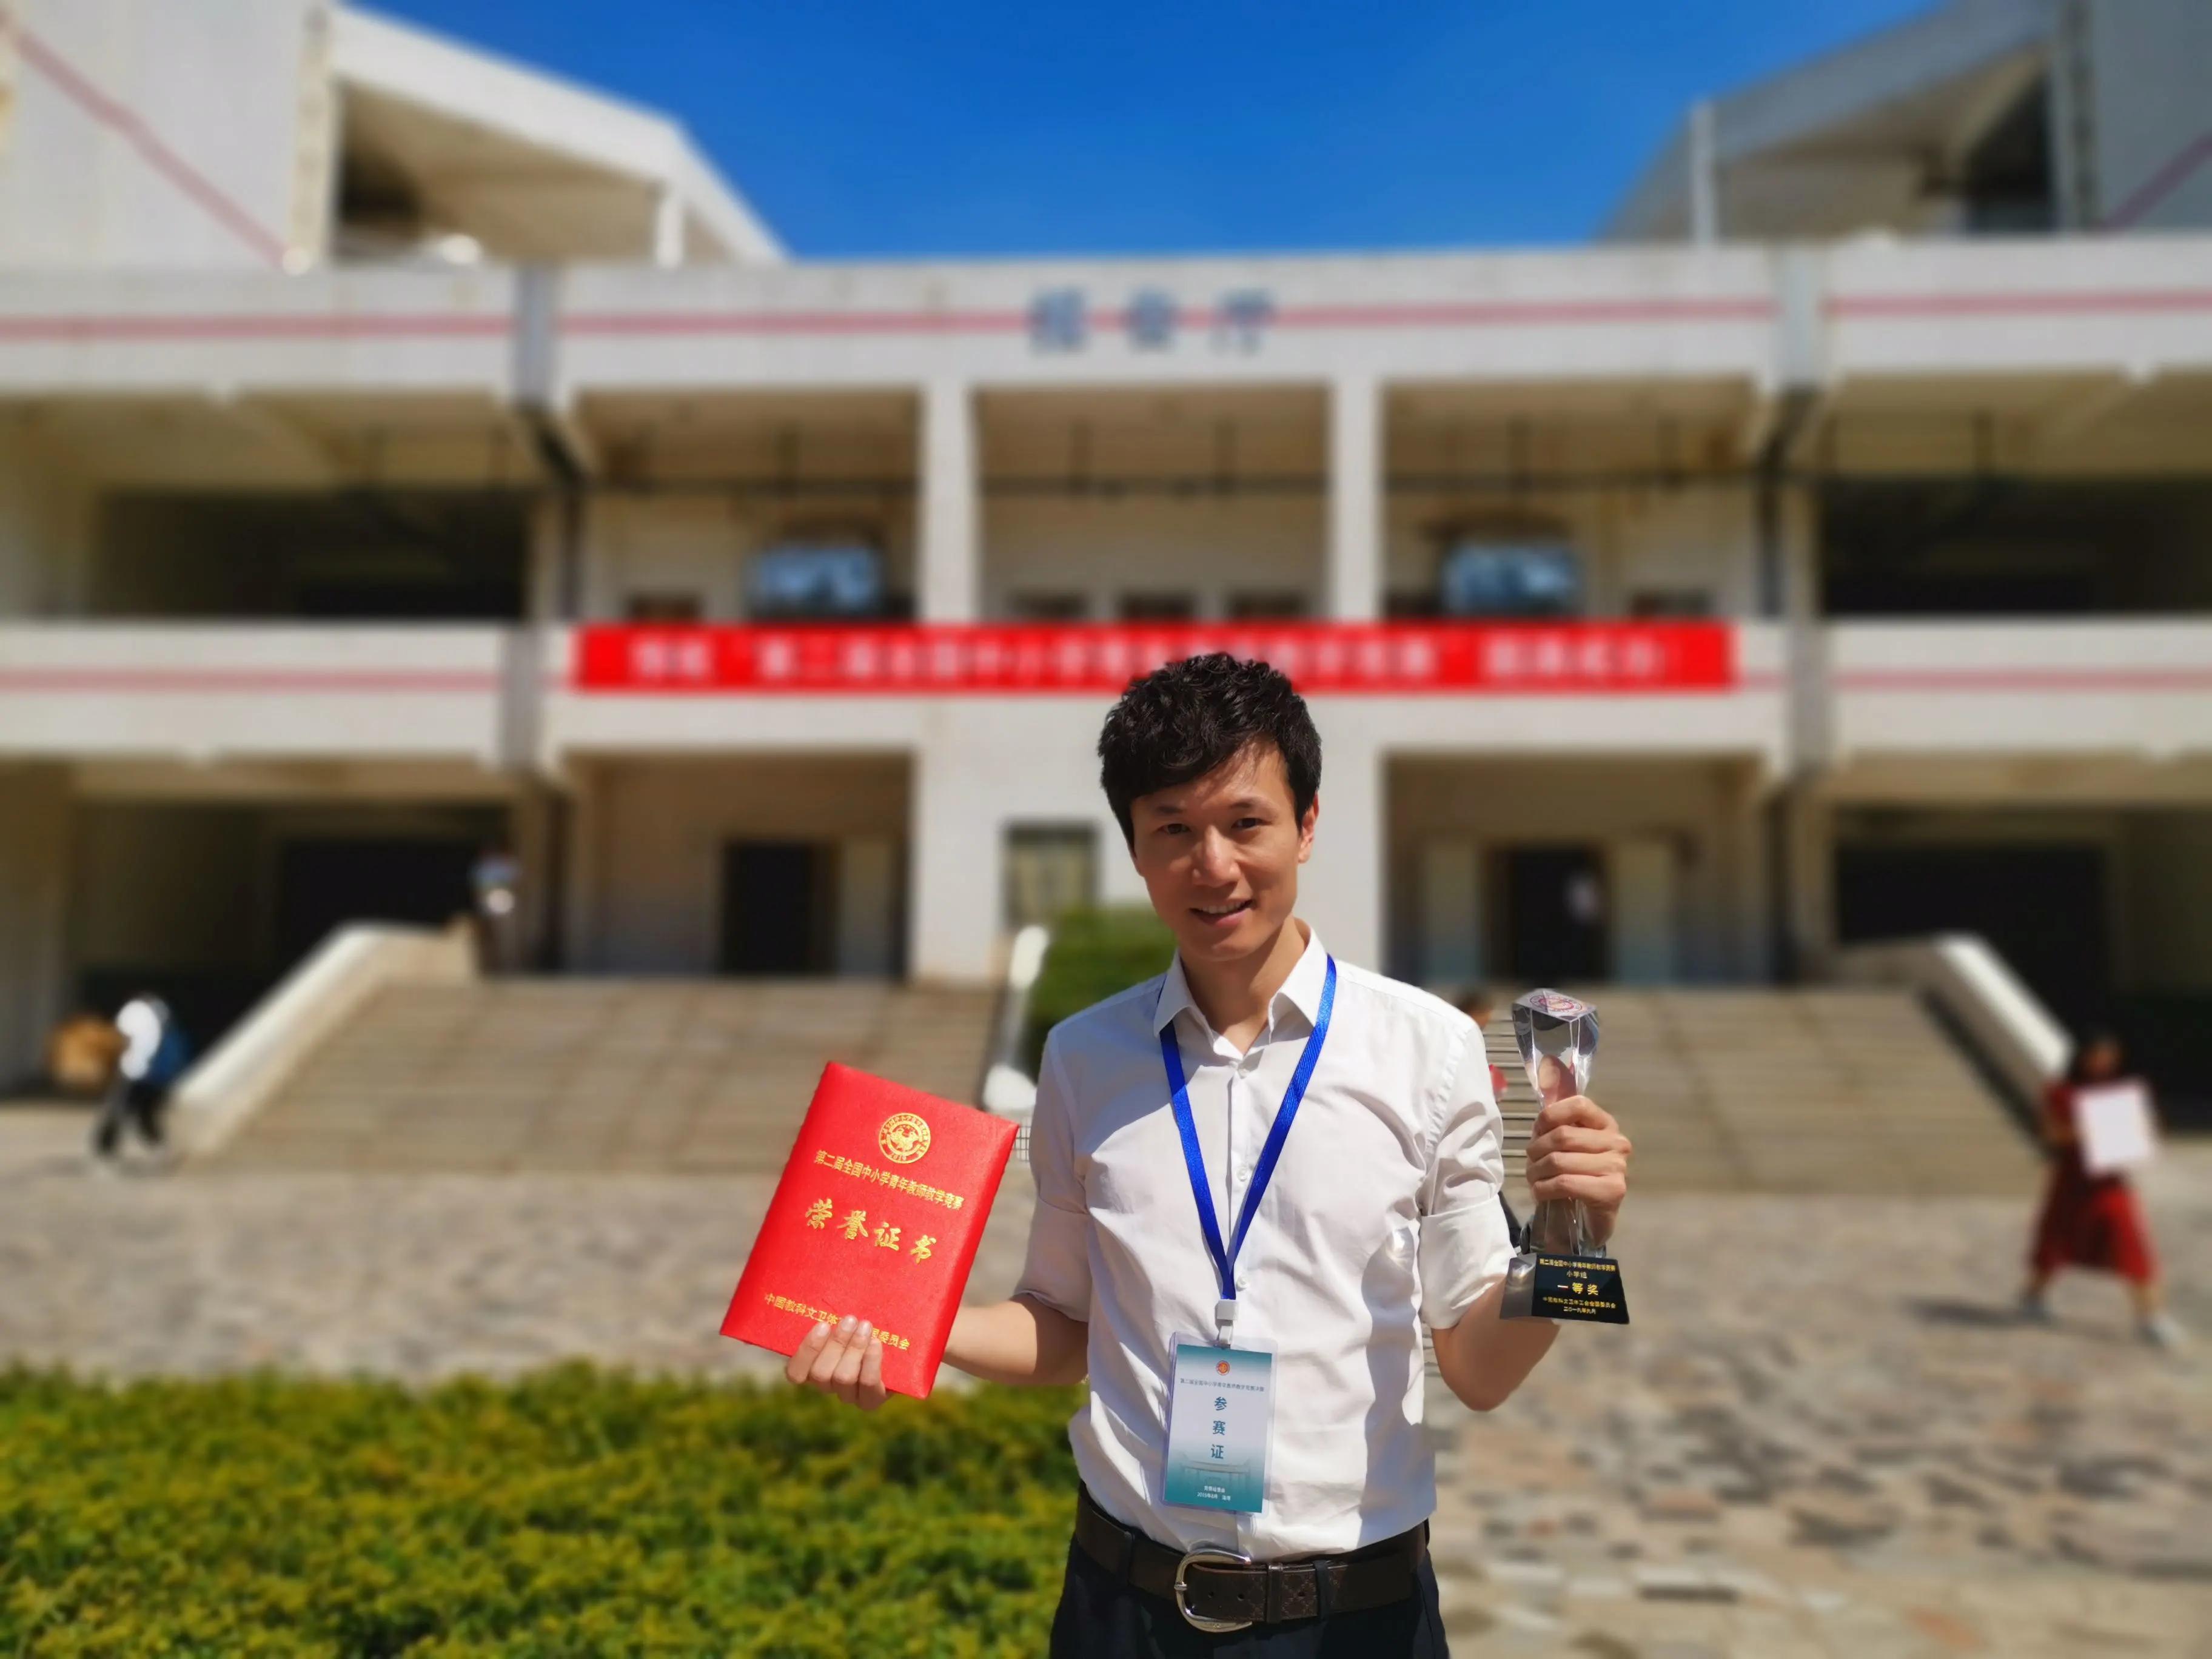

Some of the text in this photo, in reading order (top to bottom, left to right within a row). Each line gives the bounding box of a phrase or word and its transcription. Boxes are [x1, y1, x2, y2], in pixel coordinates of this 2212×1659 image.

[814, 1150, 965, 1210] 第二届全国中小学青年教师教学竞赛
[805, 1198, 937, 1264] 荣誉证书
[1557, 1282, 1598, 1296] 一等奖
[1211, 1396, 1227, 1460] 参赛证
